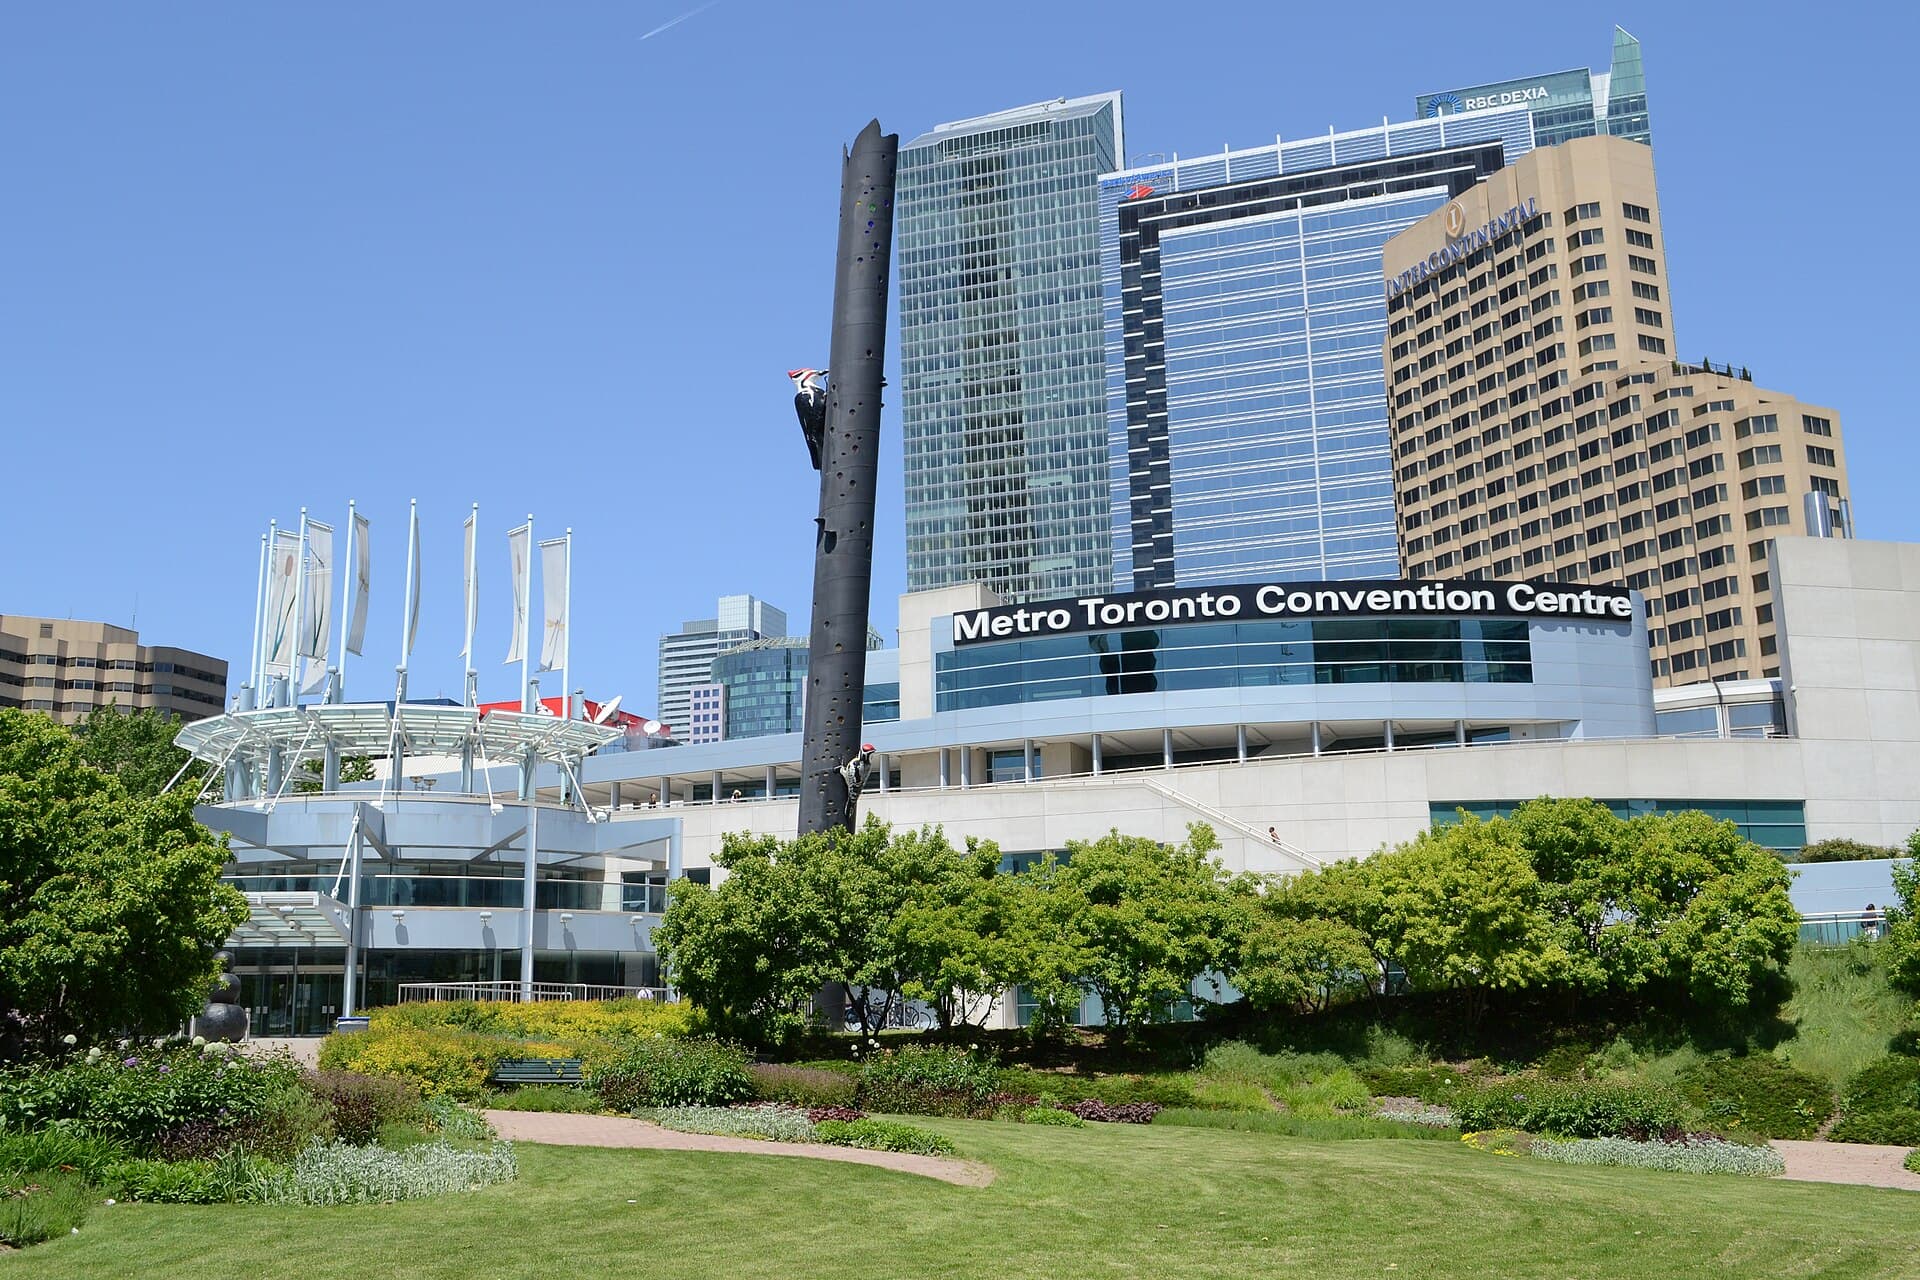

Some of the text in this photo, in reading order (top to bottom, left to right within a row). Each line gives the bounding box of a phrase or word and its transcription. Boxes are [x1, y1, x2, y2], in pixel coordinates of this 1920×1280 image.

[1465, 86, 1549, 110] RBC DEXIA
[953, 583, 1632, 641] Metro Toronto Convention Centre
